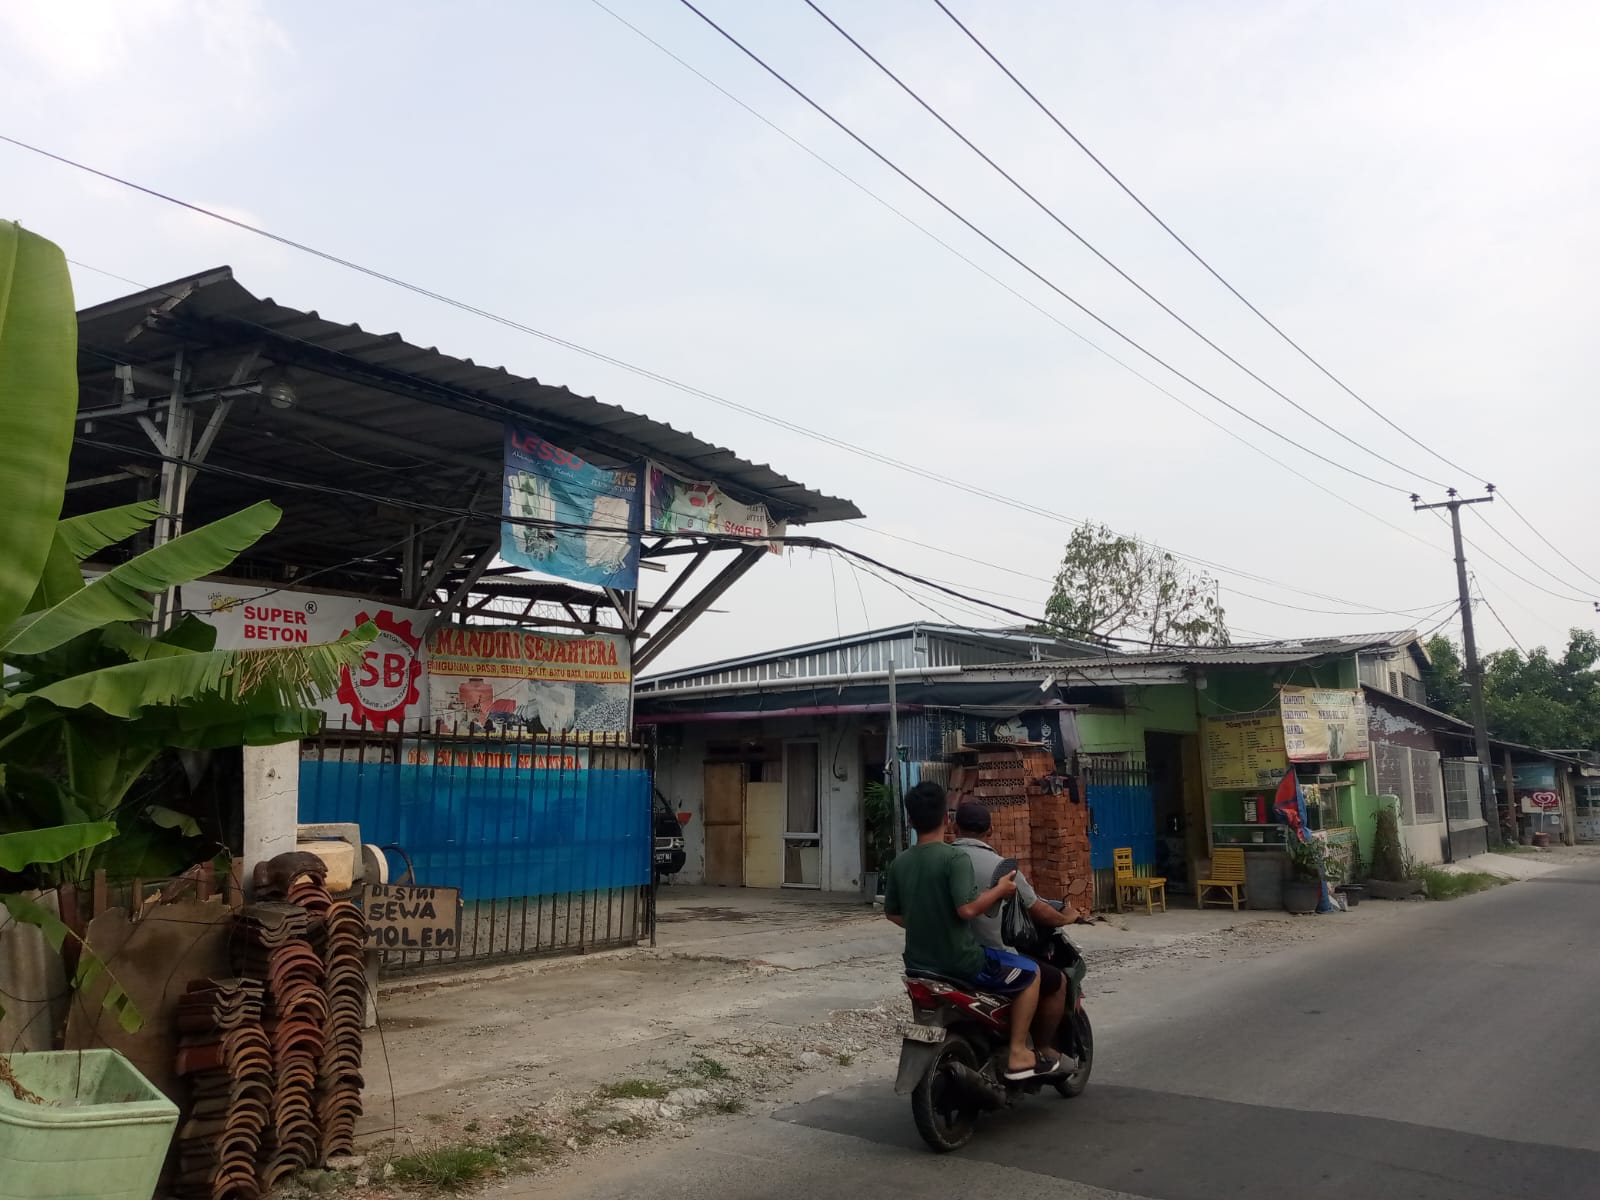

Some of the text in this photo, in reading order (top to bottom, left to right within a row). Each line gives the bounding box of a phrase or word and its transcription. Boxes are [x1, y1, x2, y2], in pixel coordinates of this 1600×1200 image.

[511, 430, 584, 471] LESSO
[244, 605, 307, 625] SUPER
[244, 624, 307, 643] BETON
[436, 627, 618, 666] MANDIRI SEJAHTERA
[360, 650, 406, 688] SB
[368, 901, 437, 921] SEWA
[363, 924, 454, 947] MOLEN
